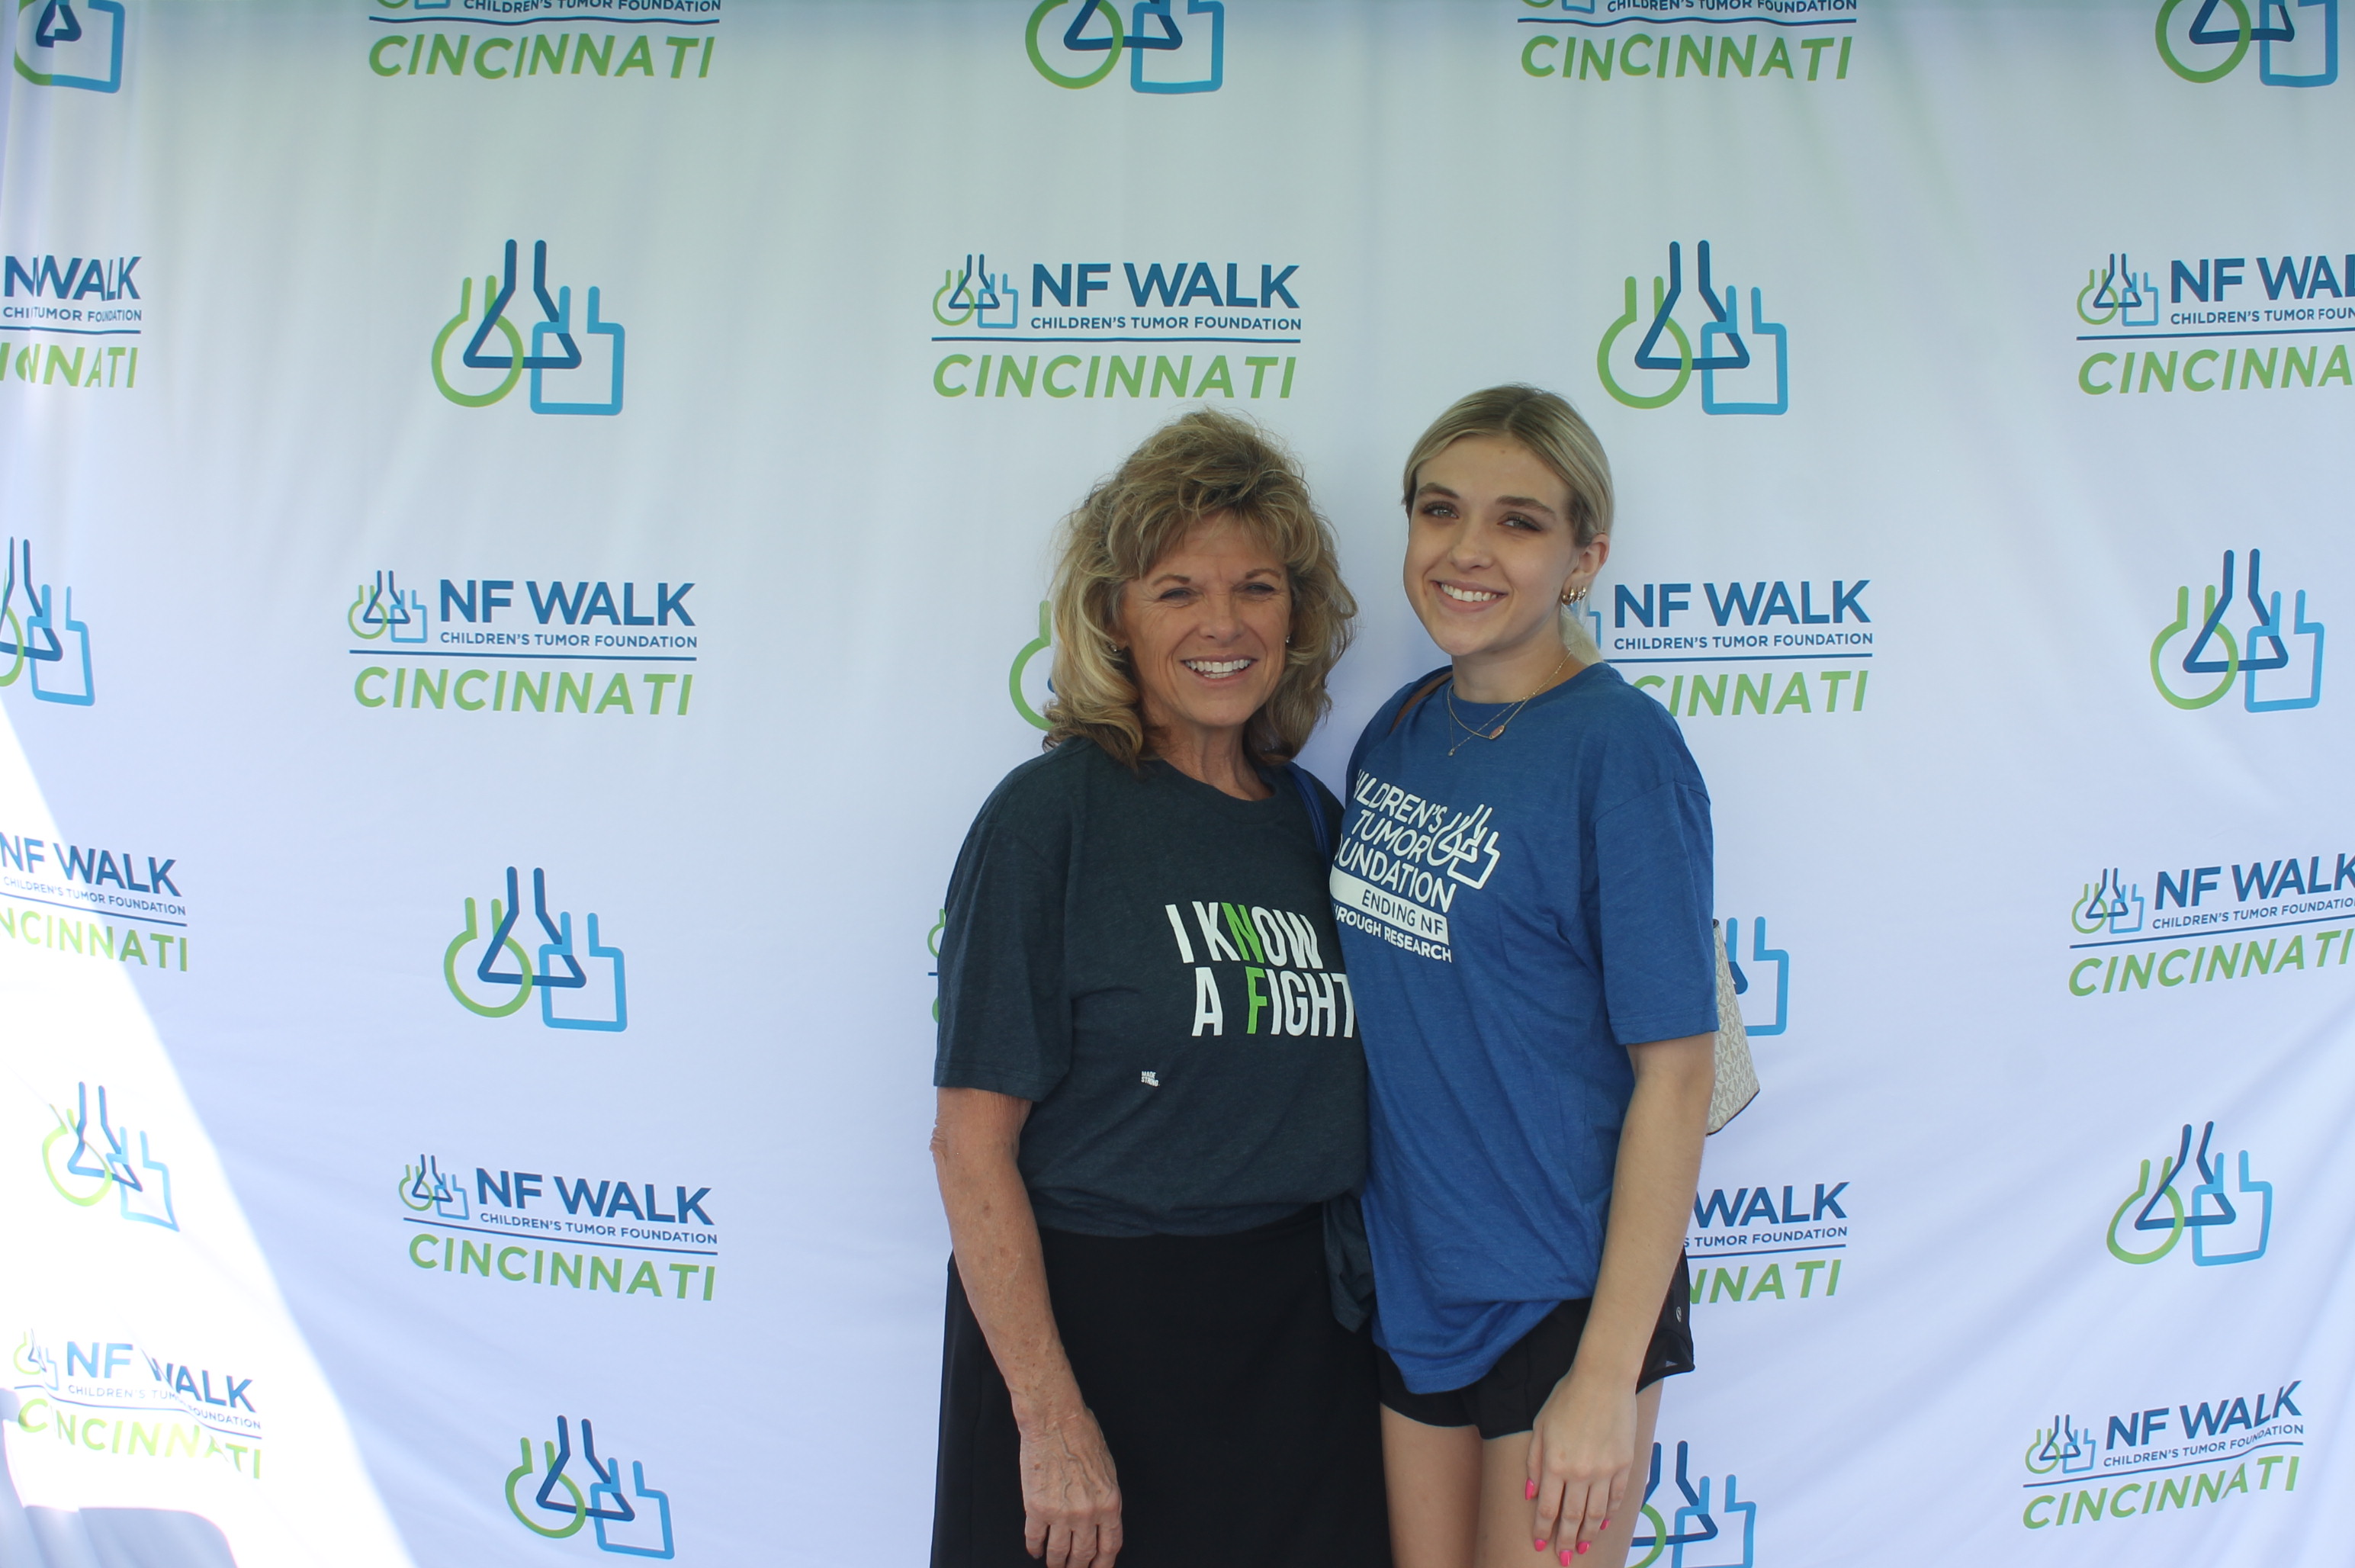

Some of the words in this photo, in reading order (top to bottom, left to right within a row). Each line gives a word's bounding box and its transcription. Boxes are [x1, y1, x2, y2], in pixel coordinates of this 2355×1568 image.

[464, 0, 552, 13] CHILDREN'S
[618, 0, 721, 12] FOUNDATION
[1607, 0, 1695, 13] CHILDREN'S
[1757, 0, 1857, 14] FOUNDATION
[369, 33, 715, 79] CINCINNATI
[1521, 33, 1853, 82] CINCINNATI
[1032, 263, 1111, 308] NF
[1123, 262, 1301, 309] WALK
[2170, 258, 2245, 304] NF
[87, 308, 143, 323] FOUNDATION
[1030, 316, 1126, 329] CHILDREN'S
[1131, 316, 1190, 329] TUMOR
[1194, 316, 1302, 331] FOUNDATION
[2170, 310, 2260, 325] CHILDREN'S
[2263, 309, 2315, 322] TUMOR
[933, 354, 1297, 399] CINCINNATI
[2078, 344, 2353, 395] CINCINNA
[439, 579, 514, 623] NF
[526, 580, 696, 627] WALK
[1614, 583, 1692, 628] NF
[1702, 580, 1871, 627] WALK
[440, 631, 530, 646] CHILDREN'S
[535, 634, 590, 647] TUMOR
[595, 635, 698, 648] FOUNDATION
[1614, 636, 1708, 651] CHILDREN'S
[1712, 635, 1768, 648] TUMOR
[1773, 633, 1874, 647] FOUNDATION
[354, 666, 693, 716] CINCINNATI
[1351, 808, 1430, 863] TUMOR
[0, 831, 46, 874] NF
[53, 842, 182, 898] WALK
[1335, 833, 1457, 914] UNDATION
[2154, 866, 2222, 911] NF
[2231, 853, 2355, 902] WALK
[4, 876, 64, 897] CHILDREN'S
[66, 888, 106, 904] TUMOR
[108, 895, 186, 916] FOUNDATION
[1361, 888, 1416, 926] ENDING
[1421, 915, 1444, 936] NF
[2152, 912, 2229, 930] CHILDREN'S
[2233, 907, 2278, 921] TUMOR
[2281, 897, 2355, 915] FOUNDATIO
[1165, 904, 1194, 963] I
[1191, 901, 1323, 969] KNOW
[1334, 902, 1382, 937] ROUGH
[1384, 928, 1452, 963] RESEARCH
[2068, 927, 2354, 997] CINCINNATI
[1191, 966, 1223, 1036] A
[1245, 966, 1355, 1038] FIGHT
[476, 1168, 543, 1209] NF
[553, 1175, 715, 1226] WALK
[1693, 1181, 1850, 1229] WALK
[480, 1212, 561, 1231] CHILDREN'S
[567, 1222, 616, 1236] TUMOR
[621, 1226, 718, 1245] FOUNDATION
[1695, 1235, 1747, 1248] TUMOR
[1752, 1226, 1848, 1244] FOUNDATION
[409, 1233, 715, 1301] CINCINNATI
[67, 1341, 133, 1379] NF
[68, 1384, 146, 1399] CHILDREN'S
[2106, 1407, 2170, 1451] NF
[2179, 1380, 2303, 1440] WALK
[18, 1398, 261, 1480] CNCINNATI
[2103, 1448, 2179, 1467] CHILDREN'S
[2183, 1441, 2225, 1457] TUMOR
[2230, 1424, 2304, 1450] FOUNDATION
[2022, 1454, 2300, 1530] CINCINNATI
